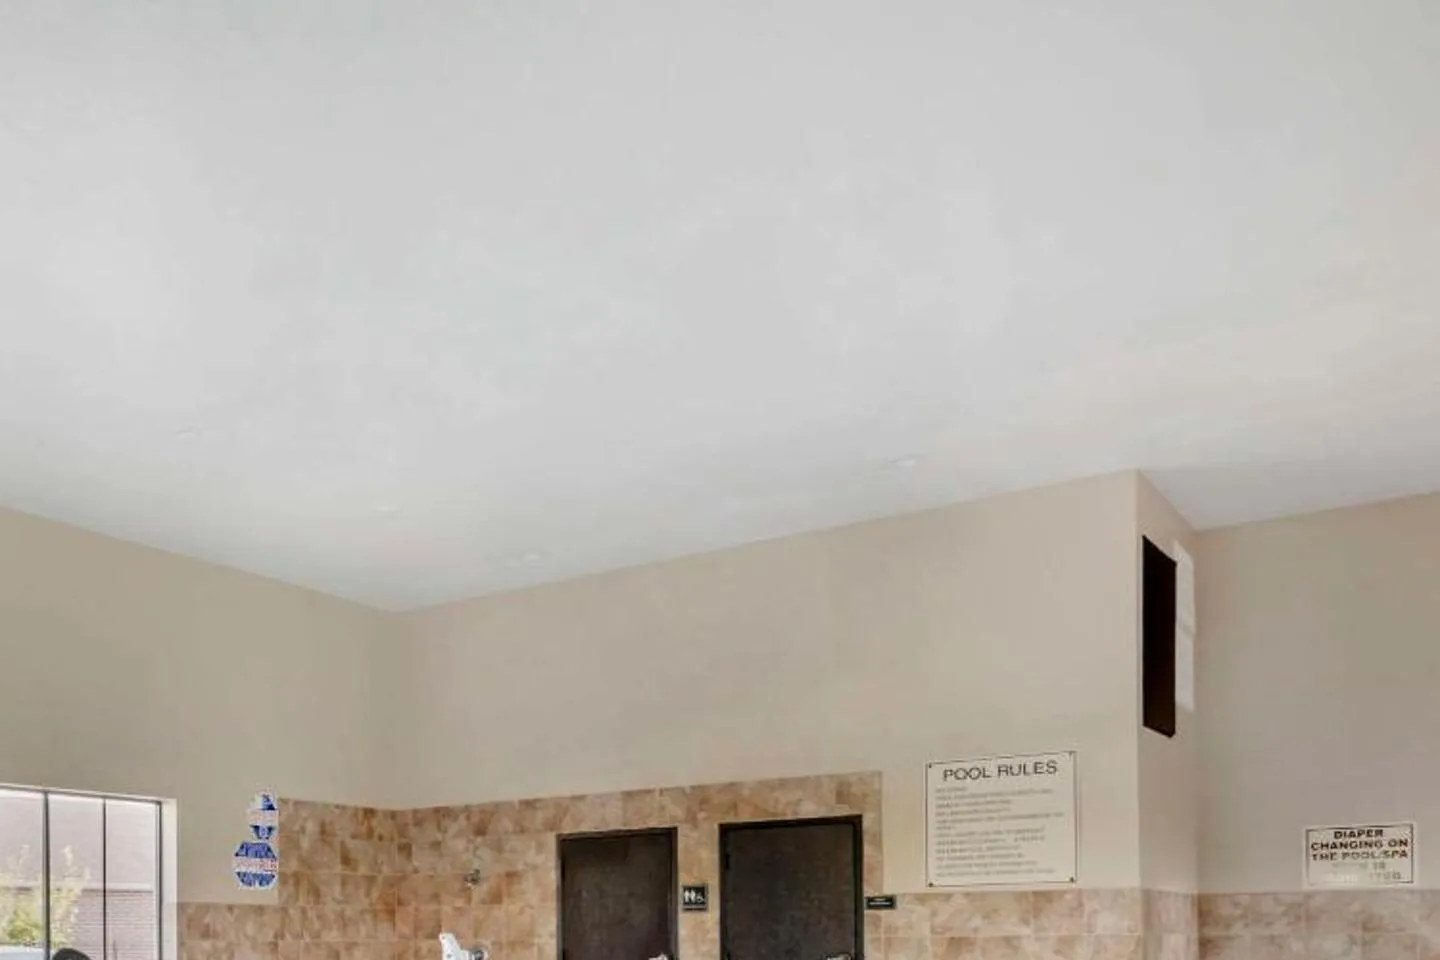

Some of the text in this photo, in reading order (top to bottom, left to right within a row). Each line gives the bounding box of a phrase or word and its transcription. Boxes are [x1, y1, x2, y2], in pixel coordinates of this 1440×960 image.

[943, 760, 1058, 781] POOL RULES
[1334, 829, 1383, 839] DIAPER
[1311, 838, 1408, 851] CHANGING ON
[1312, 852, 1337, 861] THE
